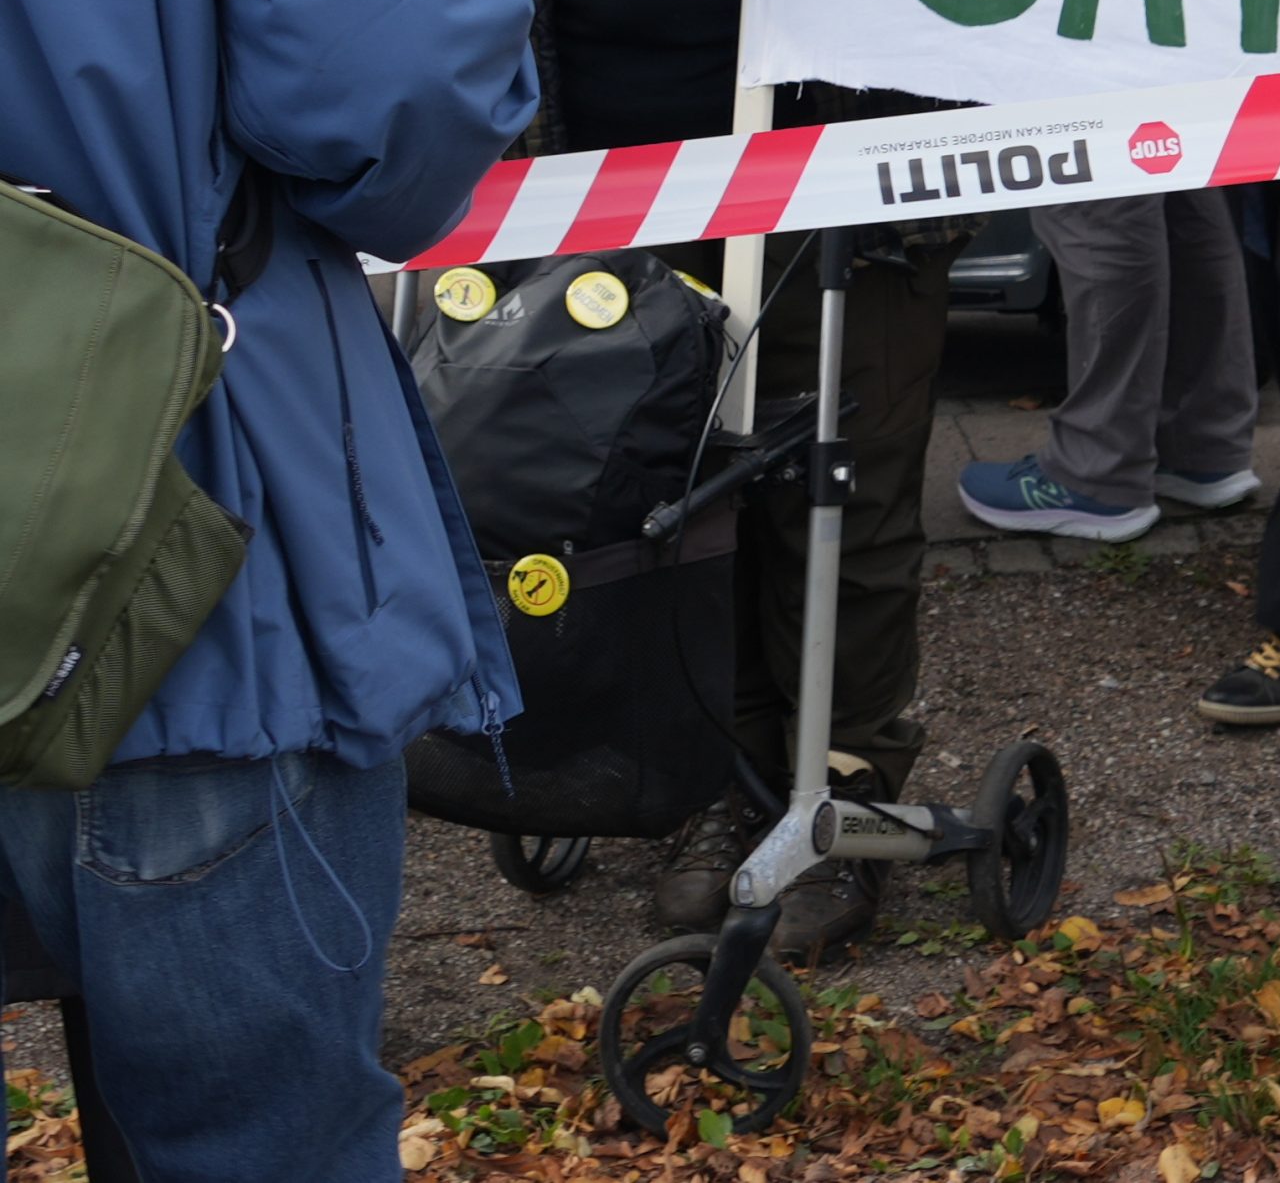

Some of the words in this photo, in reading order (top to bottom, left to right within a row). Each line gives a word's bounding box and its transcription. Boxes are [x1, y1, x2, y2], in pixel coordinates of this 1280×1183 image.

[951, 129, 1012, 145] MEDFØRE
[1015, 127, 1043, 138] KAN
[1047, 119, 1103, 137] PASSAGE
[858, 136, 948, 155] STRAFANSVA
[1130, 137, 1181, 159] STOP
[877, 139, 1093, 205] POLITI
